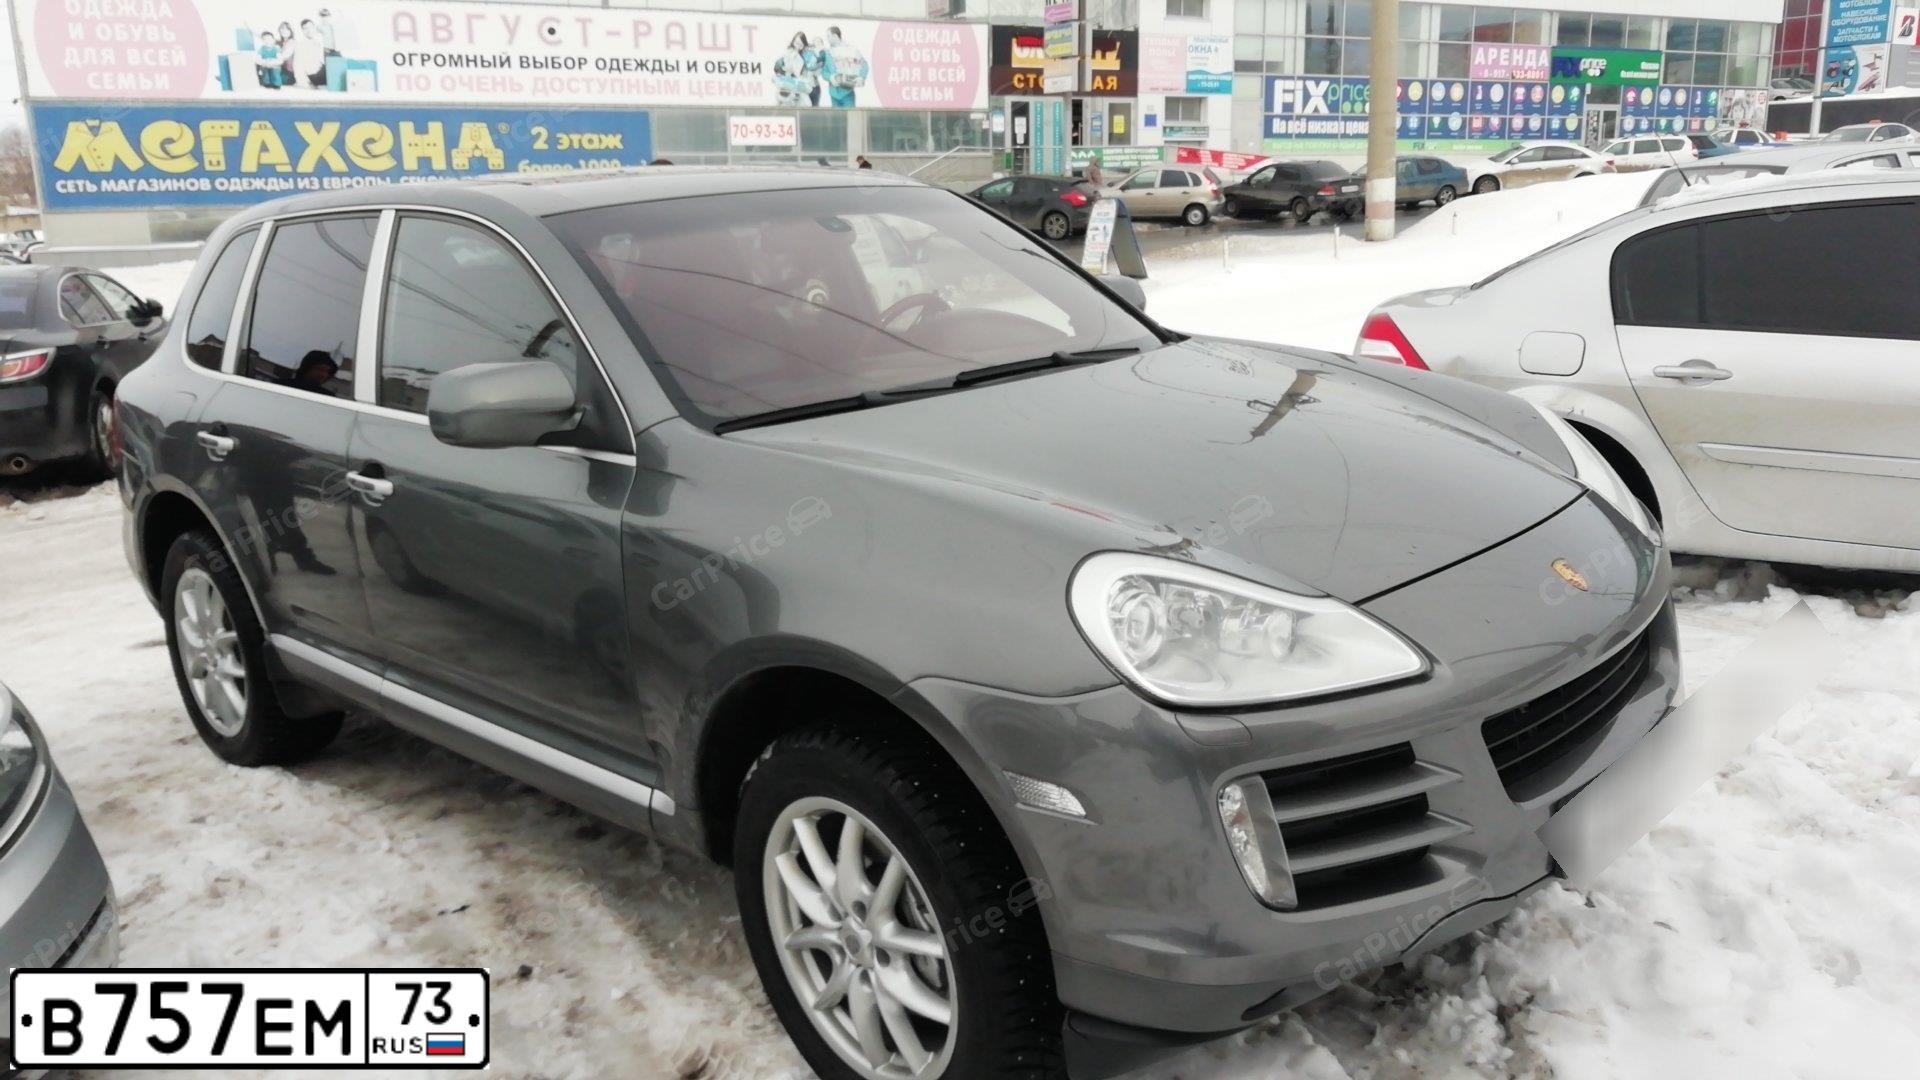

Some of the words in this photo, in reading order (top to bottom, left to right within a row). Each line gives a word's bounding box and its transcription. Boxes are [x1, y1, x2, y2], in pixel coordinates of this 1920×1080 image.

[65, 0, 174, 20] ОДЕЖДА
[68, 22, 85, 40] И
[95, 22, 176, 42] ОБУВЬ
[391, 11, 758, 53] АВГУСТ-РАШТ
[892, 28, 961, 47] ОДЕЖДА
[64, 48, 116, 68] ДЛЯ
[127, 46, 187, 67] ВСЕЙ
[893, 48, 904, 62] И
[910, 48, 960, 64] ОБУВЬ
[1188, 45, 1212, 54] ОКНА
[1474, 47, 1549, 69] АРЕНДА
[393, 52, 511, 69] ОГРОМНЫЙ
[519, 55, 587, 70] ВЫБОР
[595, 57, 680, 75] ОДЕЖДЫ
[687, 60, 698, 73] И
[704, 60, 762, 75] ОБУВИ
[87, 72, 170, 90] СЕМЬИ
[888, 66, 921, 85] ДЛЯ
[928, 65, 967, 83] ВСЕЙ
[396, 73, 431, 92] ПО
[440, 74, 524, 93] ОЧЕНЬ
[532, 76, 680, 97] ДОСТУПНЫМ
[689, 79, 763, 98] ЦЕНАМ
[901, 86, 954, 101] СЕМЬИ
[732, 124, 794, 139] 70-93-34
[1273, 117, 1287, 135] На
[1307, 120, 1345, 134] низкая
[530, 125, 549, 150] 2
[556, 132, 624, 150] этаж
[55, 179, 98, 193] СЕТЬ
[101, 177, 211, 192] МАГАЗИНОВ
[214, 178, 294, 193] ОДЕЖДЫ
[298, 177, 320, 190] ИЗ
